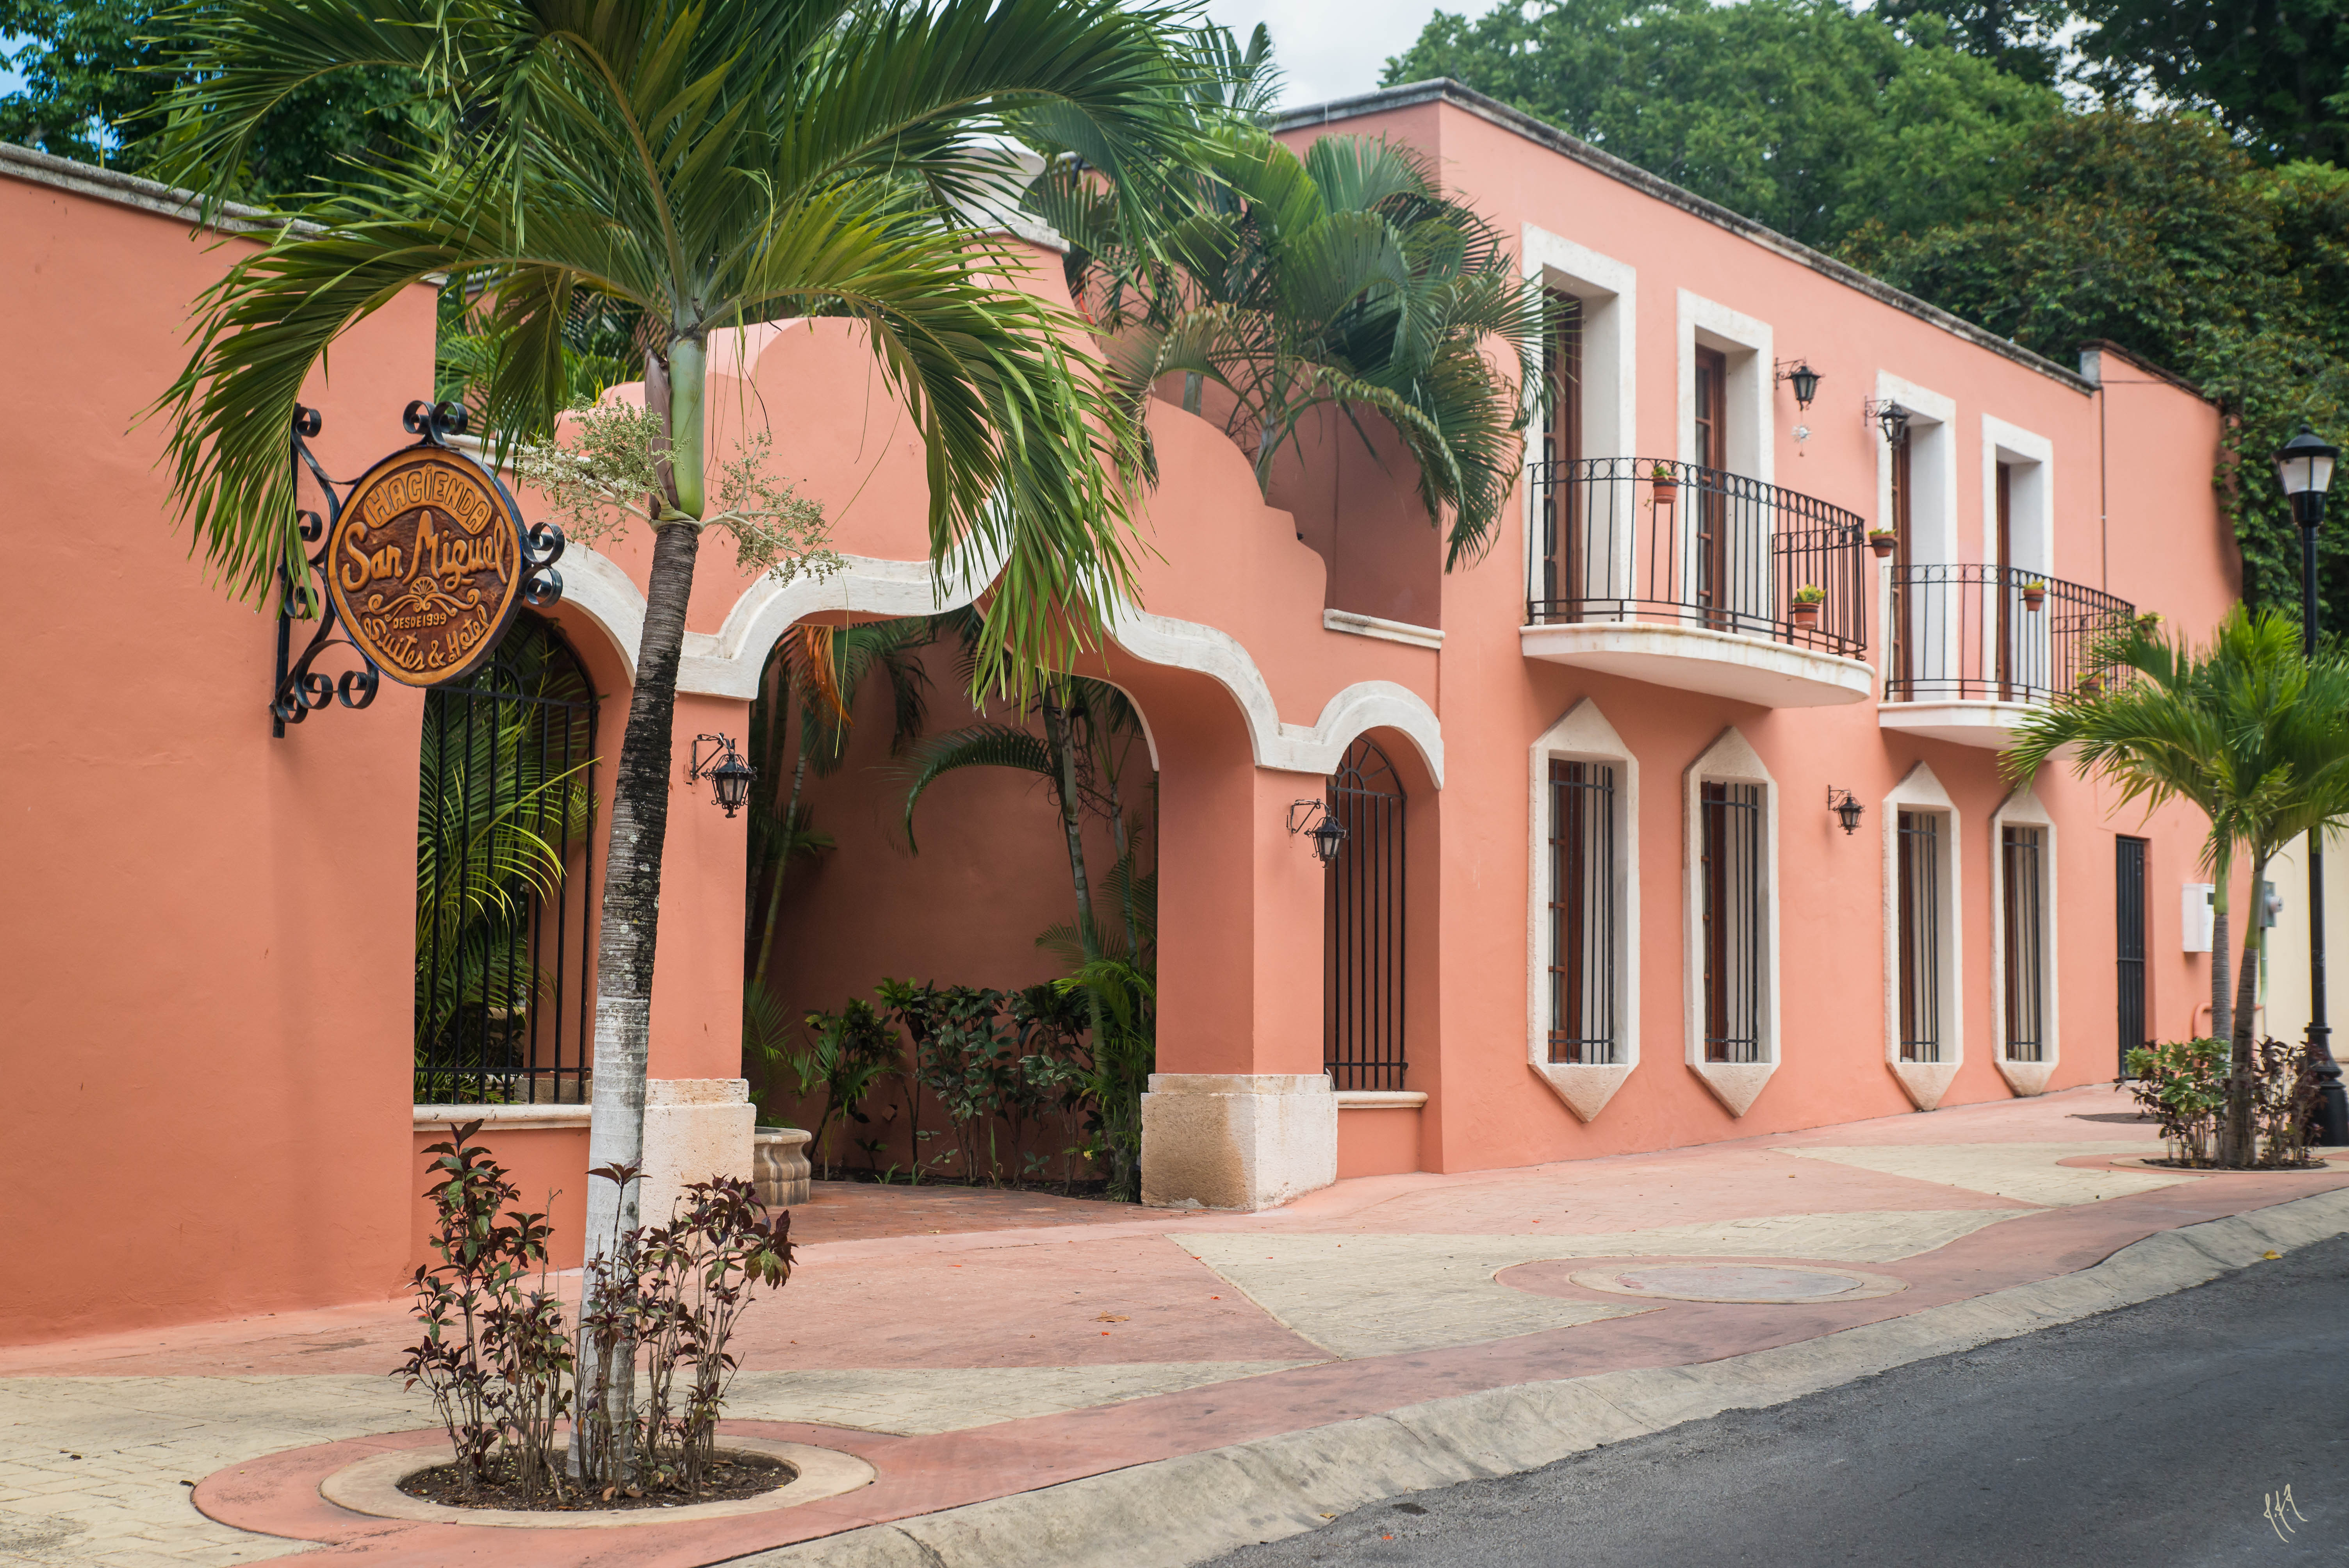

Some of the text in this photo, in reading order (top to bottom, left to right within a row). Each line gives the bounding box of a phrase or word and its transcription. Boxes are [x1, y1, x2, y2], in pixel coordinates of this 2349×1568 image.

[342, 510, 507, 593] San Miguel
[364, 604, 490, 671] Suites & Hotel
[393, 612, 447, 629] DESDE 1999
